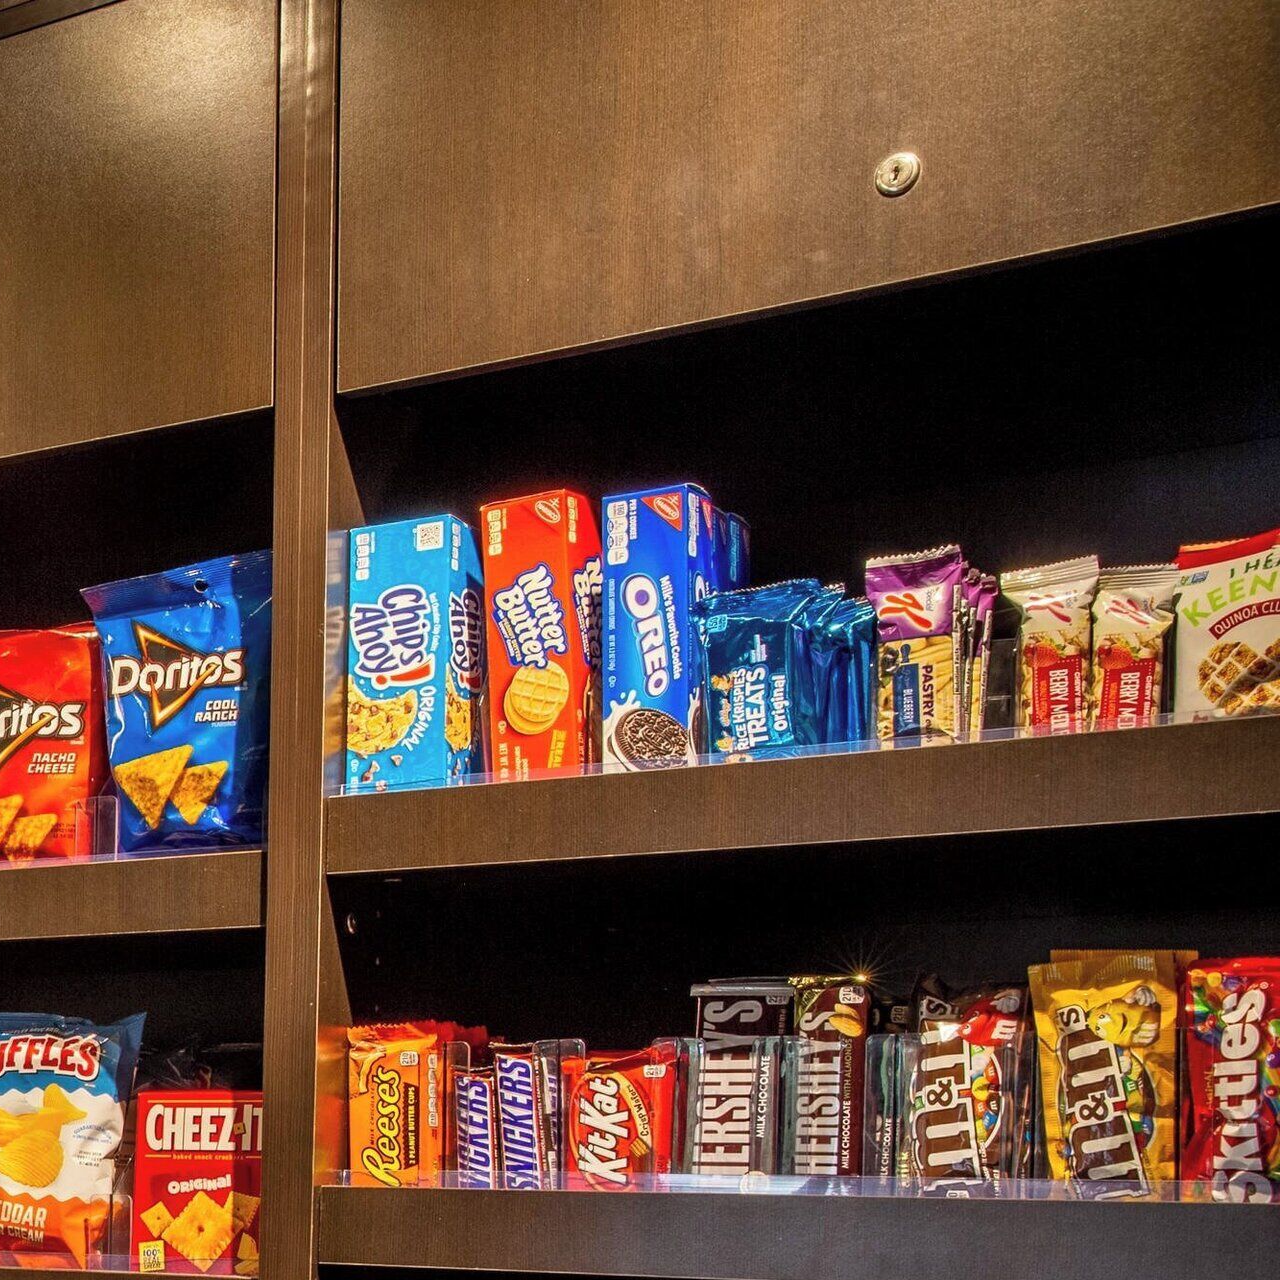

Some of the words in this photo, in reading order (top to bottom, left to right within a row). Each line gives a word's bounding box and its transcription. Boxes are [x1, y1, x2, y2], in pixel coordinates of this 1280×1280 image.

[518, 564, 567, 654] Nutter
[659, 574, 674, 605] Milk's
[380, 586, 425, 667] Chips
[495, 584, 548, 670] Butter
[665, 605, 680, 643] Favorite
[879, 592, 933, 630] K
[1214, 606, 1259, 635] QUINOA
[622, 573, 670, 697] OREO
[111, 649, 244, 696] Doritos
[671, 643, 683, 680] Cookie
[205, 699, 238, 712] COOL
[732, 668, 747, 722] KRISPIES
[746, 665, 768, 750] TREATS
[772, 674, 790, 730] Original
[902, 687, 914, 723] BLUEBERRY
[921, 664, 935, 718] PASTRY
[1120, 672, 1141, 702] BERRY
[194, 710, 238, 723] RANCH
[400, 685, 436, 752] ORIGINAL
[733, 722, 748, 750] RICE
[27, 763, 76, 775] CHEESE
[32, 752, 77, 763] NACHO
[845, 1038, 853, 1080] ALMONDS
[406, 1086, 416, 1105] CUPS
[759, 1054, 771, 1114] CHOCOLATE
[843, 1080, 851, 1100] WITH
[1212, 988, 1272, 1203] Skittles
[361, 1064, 402, 1188] Reese's
[406, 1108, 416, 1135] BUTTER
[497, 1054, 539, 1190] SNICKERS
[580, 1076, 629, 1142] Kat
[755, 1115, 765, 1139] MILK
[841, 1101, 851, 1148] CHOCOLATE
[406, 1135, 416, 1159] PEANUT
[578, 1128, 628, 1186] Kit
[840, 1148, 849, 1169] MILK
[882, 1117, 892, 1164] CHOCOLATE
